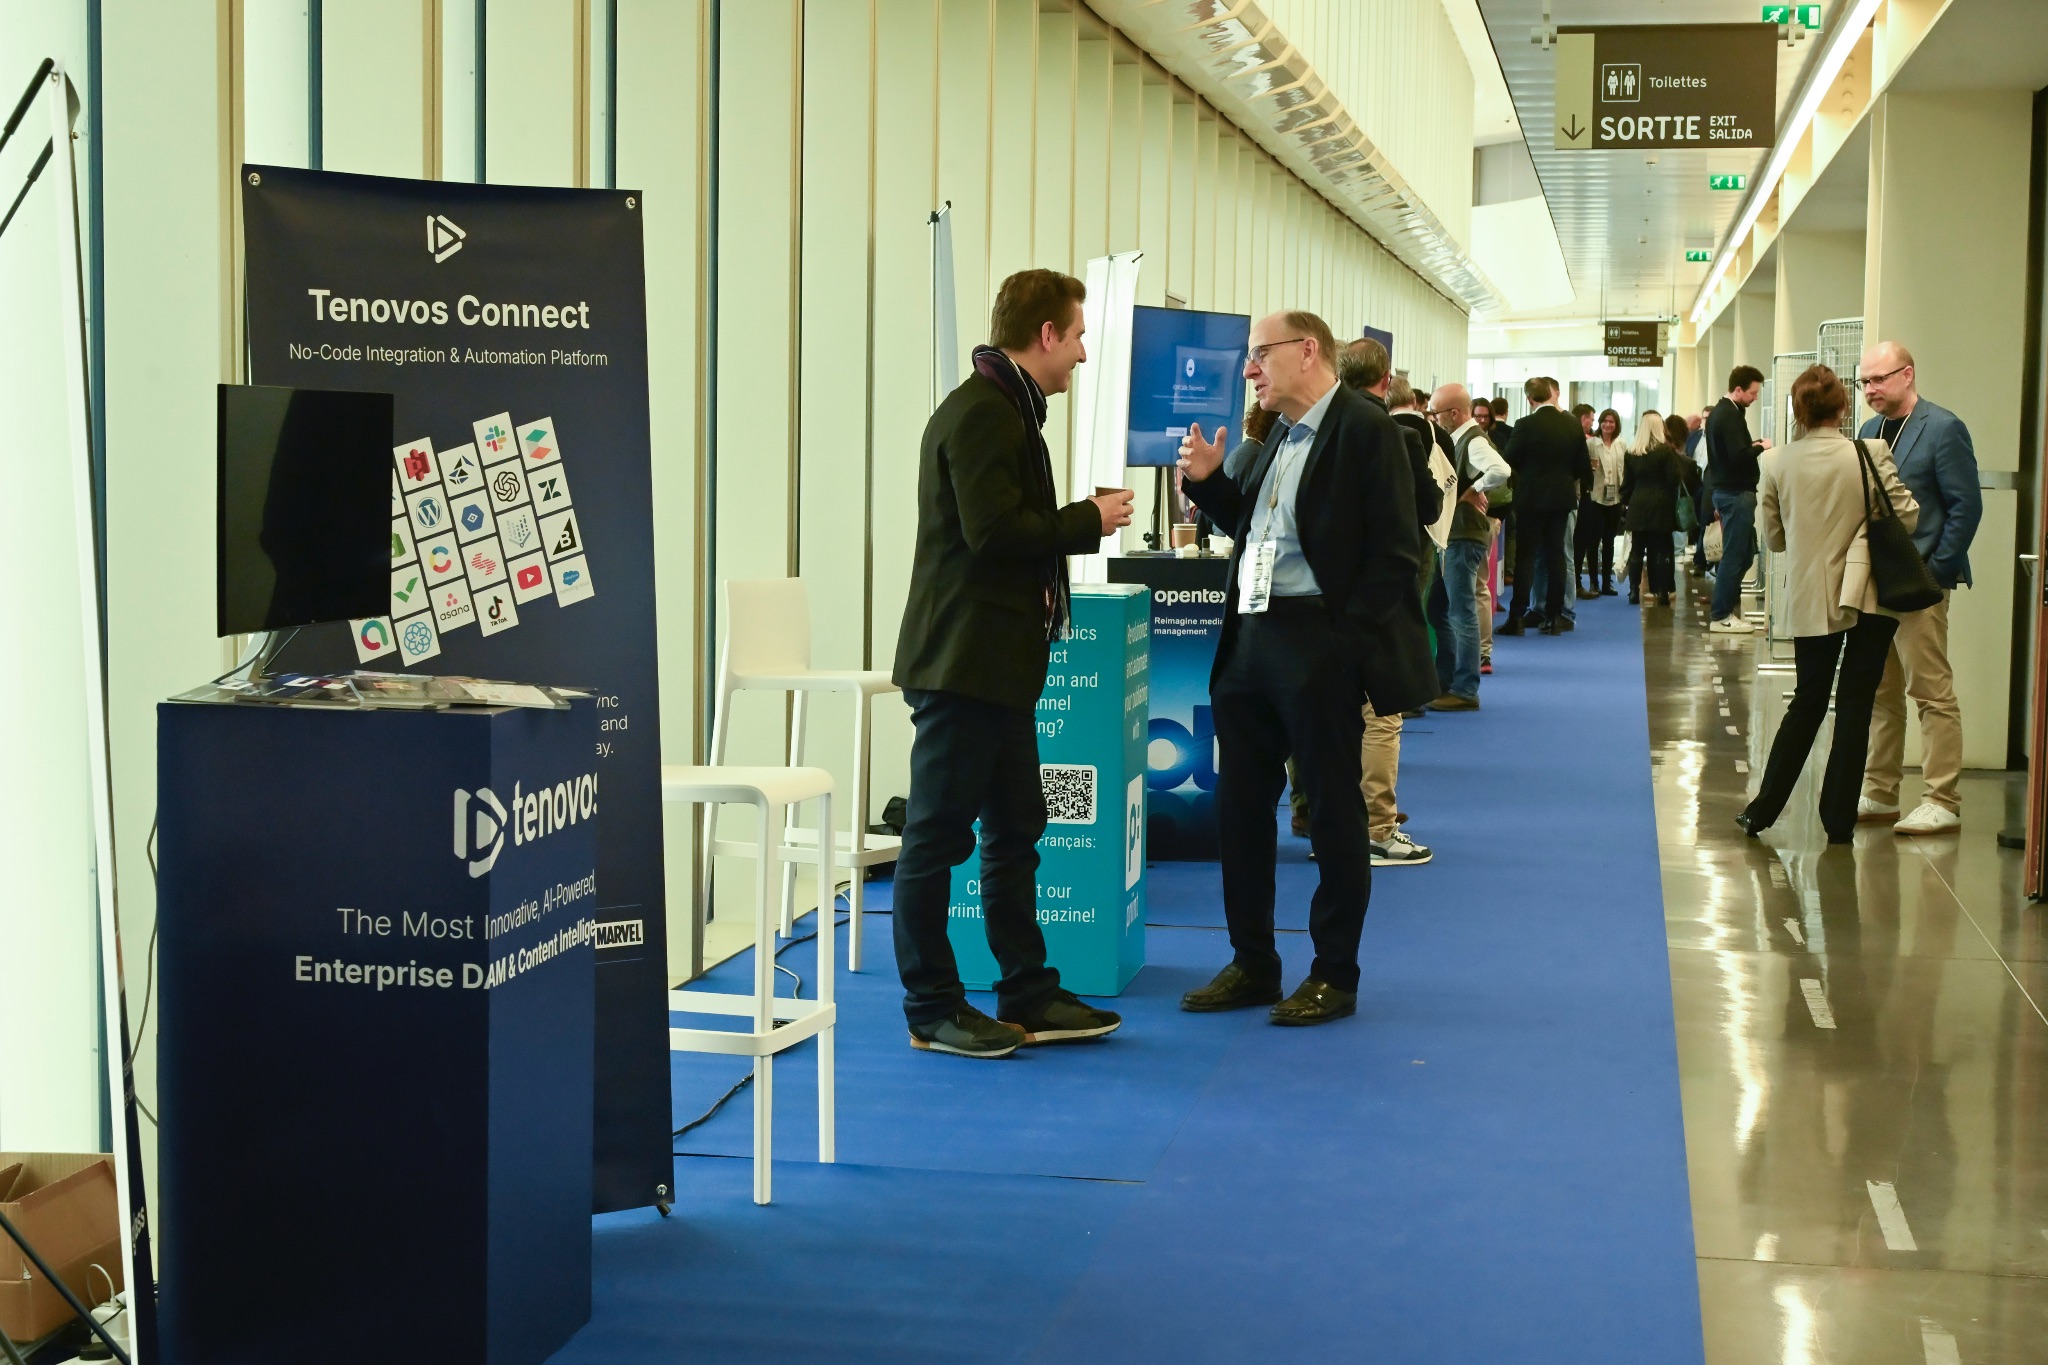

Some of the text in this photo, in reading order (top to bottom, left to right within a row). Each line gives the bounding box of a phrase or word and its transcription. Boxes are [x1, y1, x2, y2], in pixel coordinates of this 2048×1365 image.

[1649, 76, 1707, 88] Toilettes
[1600, 116, 1701, 140] SORTIE
[1710, 115, 1737, 127] EXIT
[1709, 128, 1753, 140] SALIDA
[308, 288, 590, 329] Tenovos Connect
[289, 343, 608, 366] No-Code Integration & Automation Platform
[1607, 347, 1637, 355] SORTIE
[1154, 588, 1227, 607] opentex
[439, 604, 470, 621] asana
[490, 616, 508, 627] TikTok
[1154, 617, 1198, 626] Reimagine
[1154, 628, 1208, 637] management
[1070, 672, 1098, 688] and
[600, 715, 628, 731] and
[1037, 834, 1096, 850] Français:
[1046, 885, 1072, 899] our
[336, 868, 597, 940] The Most Innovative, AI-Powered,
[1035, 907, 1096, 925] agazine!
[596, 922, 643, 947] MARVEL
[295, 917, 596, 992] Enterprise DAM & Content Intellige
